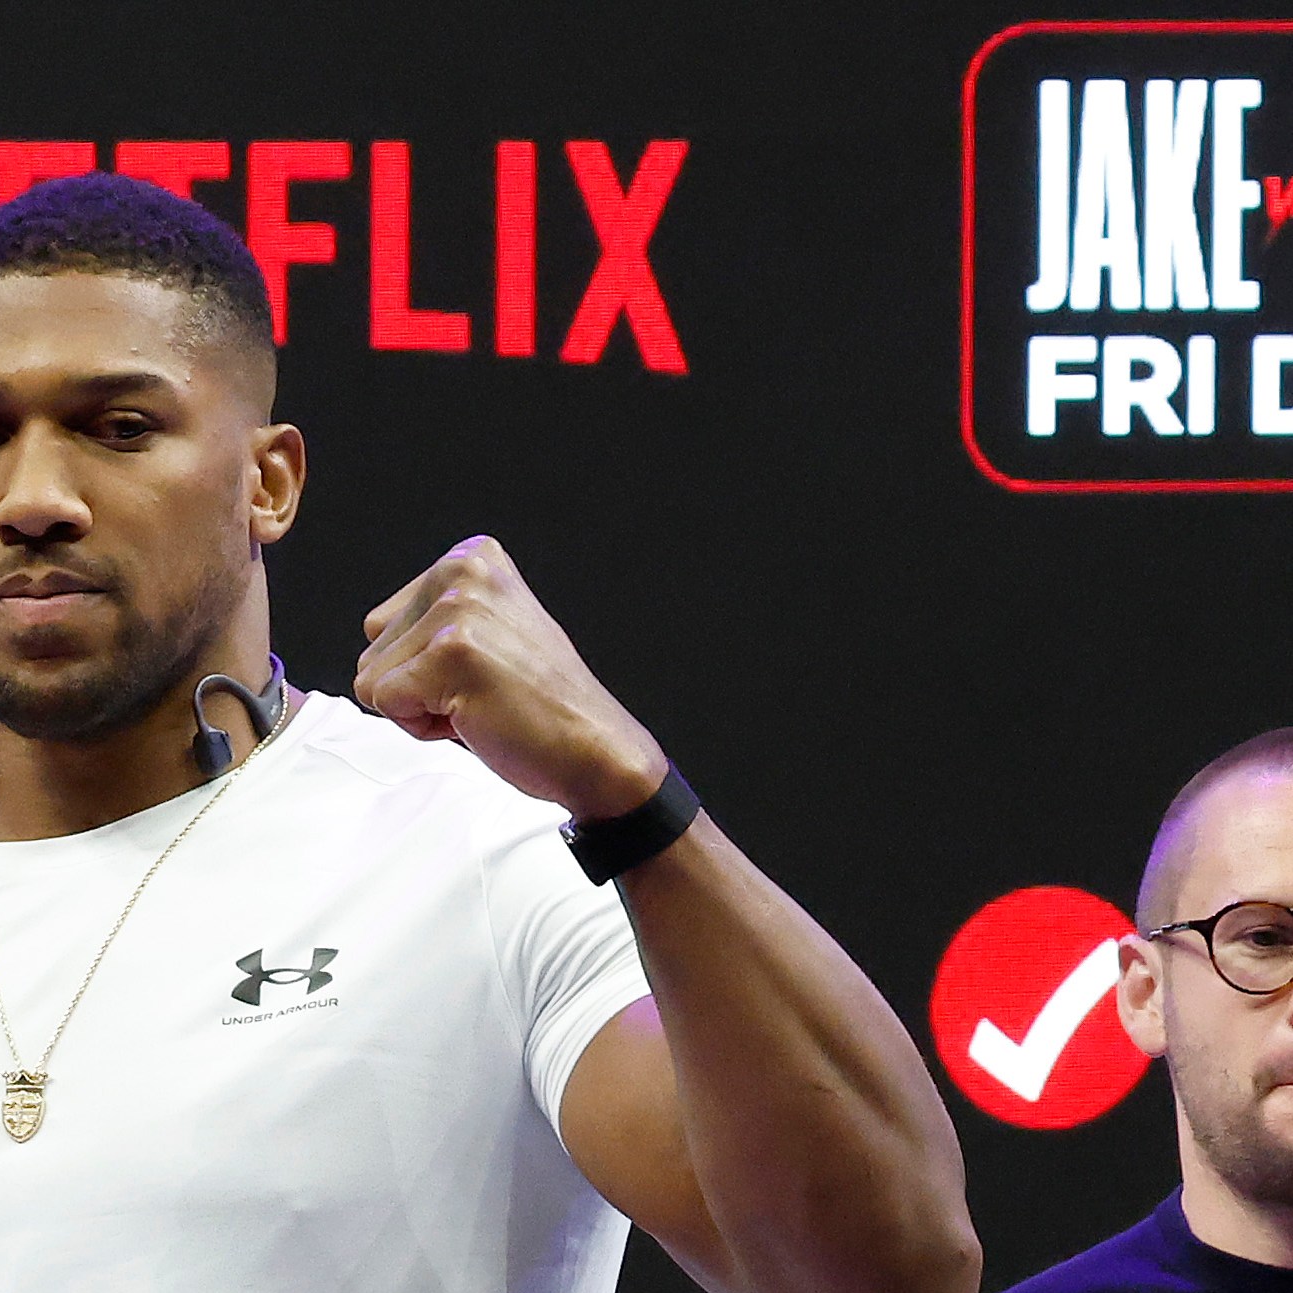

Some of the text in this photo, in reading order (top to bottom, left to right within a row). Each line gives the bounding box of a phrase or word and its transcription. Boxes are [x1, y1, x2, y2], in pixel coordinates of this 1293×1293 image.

[1026, 78, 1263, 313] JAKE
[1027, 334, 1217, 437] FRI
[221, 998, 340, 1026] UNDER ARMOUR
